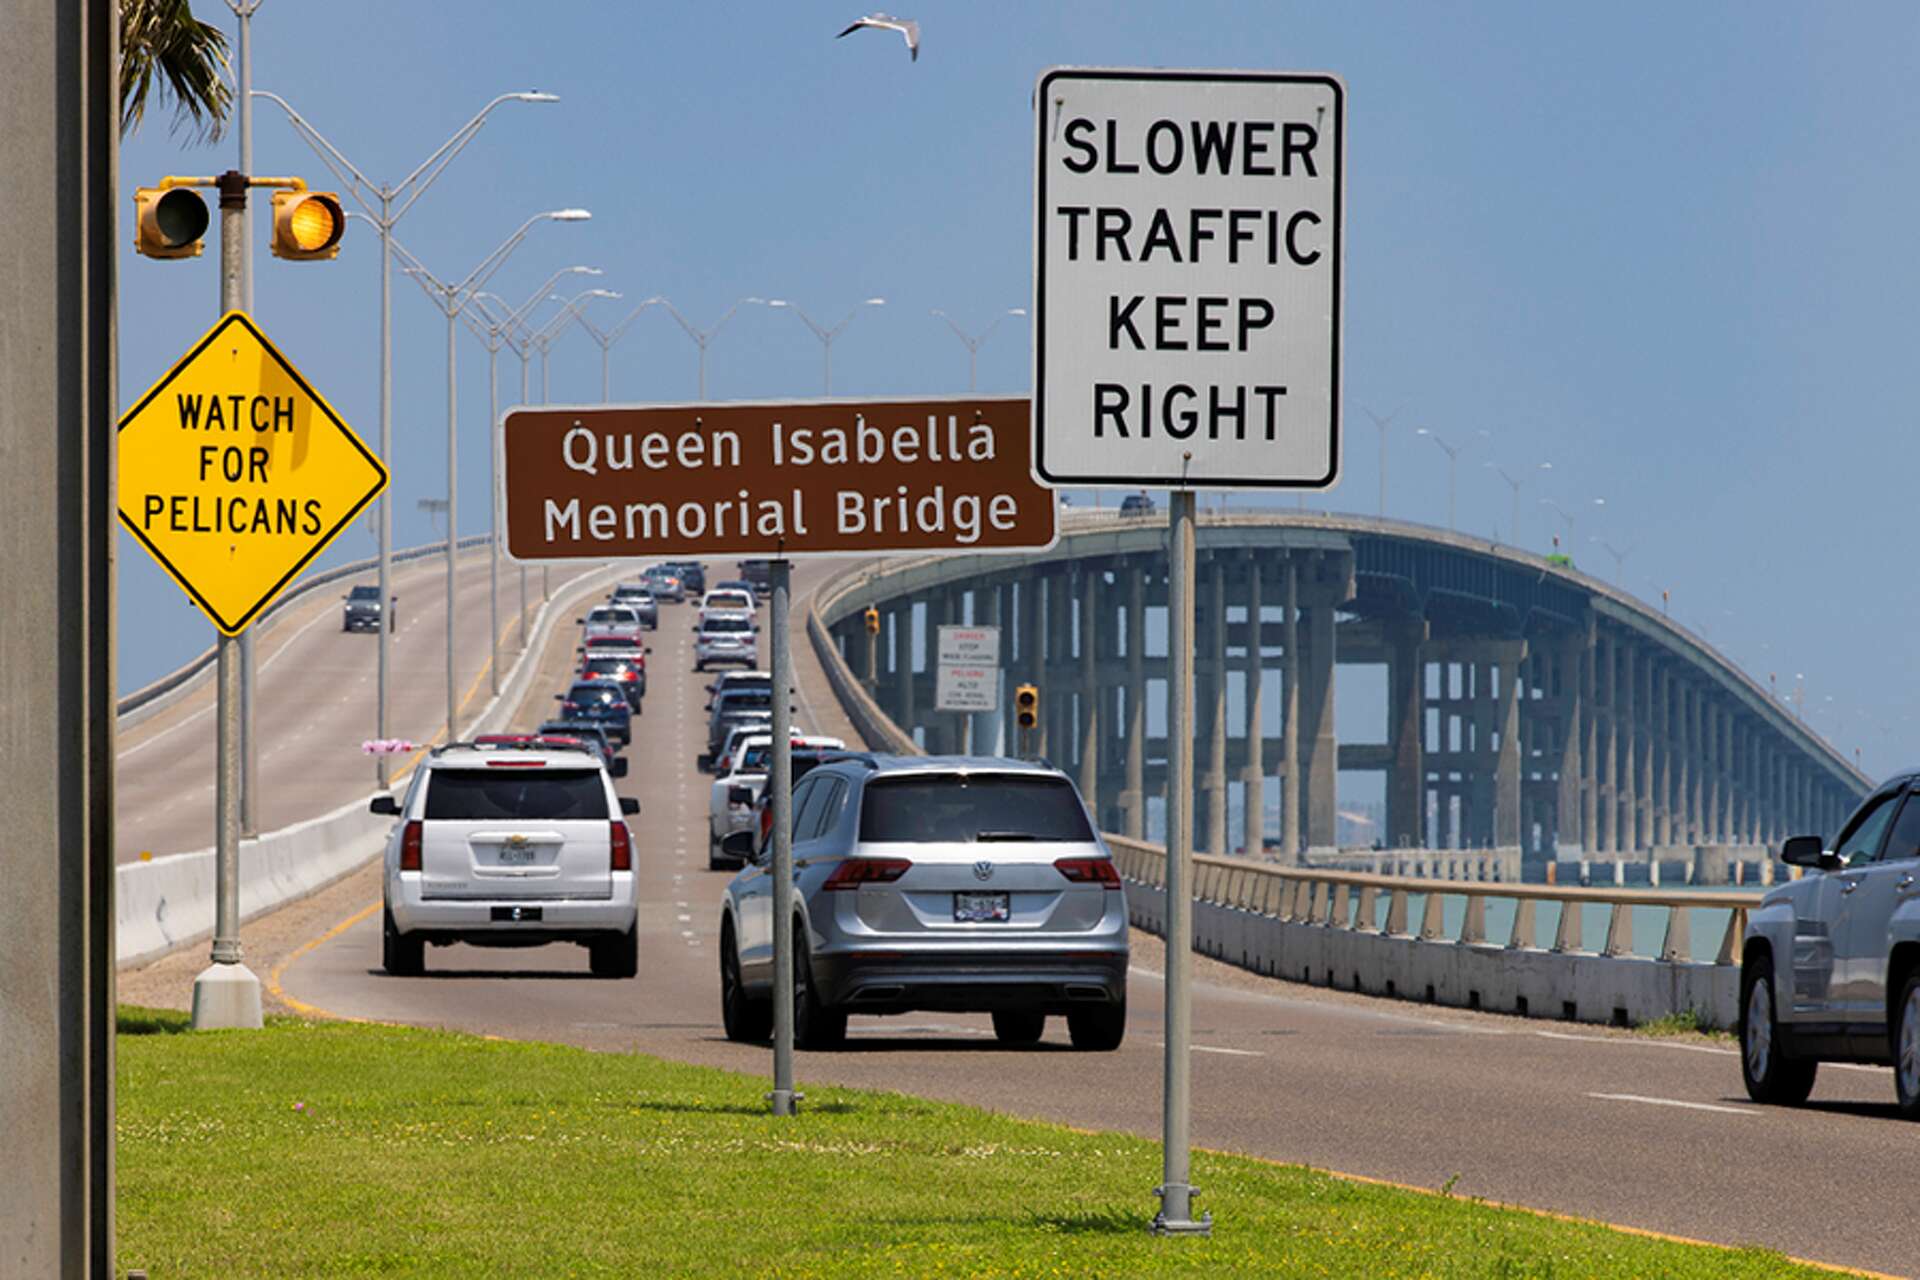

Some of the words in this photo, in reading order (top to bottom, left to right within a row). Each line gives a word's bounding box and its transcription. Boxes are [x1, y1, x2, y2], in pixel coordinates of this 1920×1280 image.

[1062, 118, 1319, 177] SLOWER
[1057, 206, 1322, 266] TRAFFIC
[1109, 295, 1275, 352] KEEP
[177, 393, 294, 433] WATCH
[1094, 383, 1288, 441] RIGHT
[200, 445, 270, 484] FOR
[562, 427, 741, 475] Queen
[773, 415, 996, 466] Isabella
[144, 494, 322, 536] PELICANS
[544, 489, 808, 542] Memorial
[837, 485, 1018, 544] Bridge
